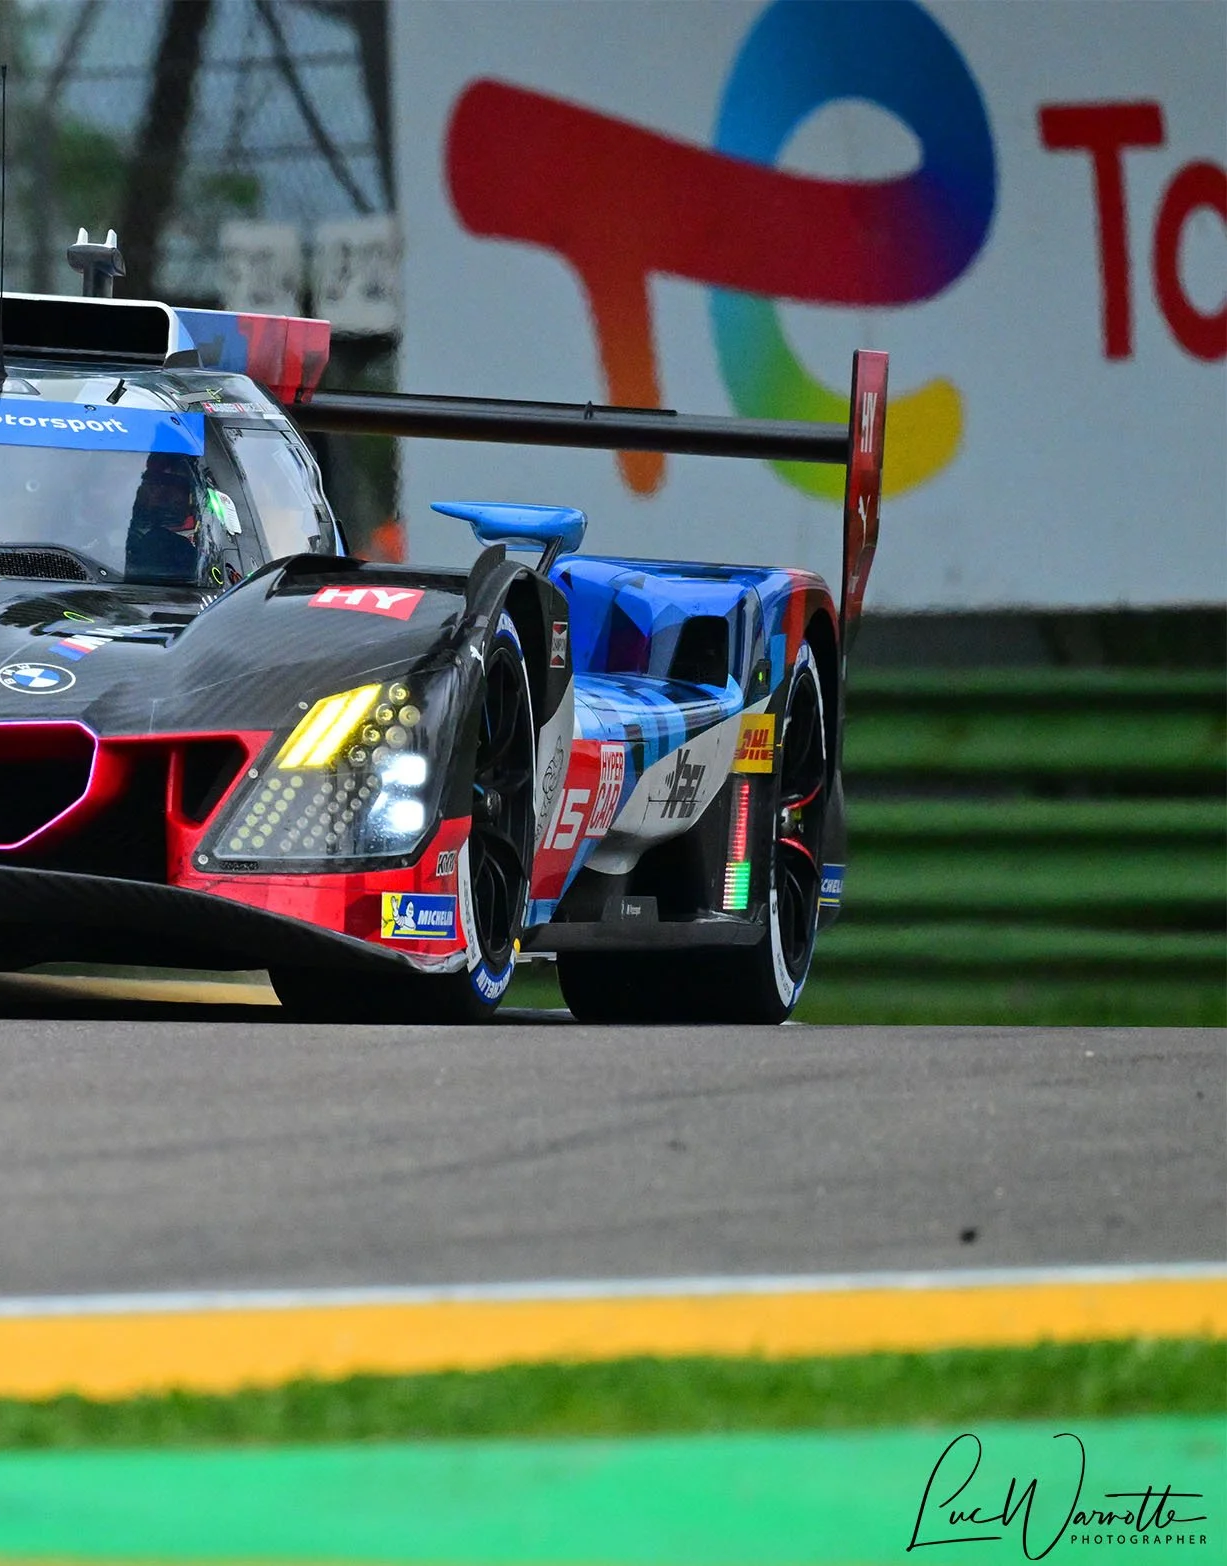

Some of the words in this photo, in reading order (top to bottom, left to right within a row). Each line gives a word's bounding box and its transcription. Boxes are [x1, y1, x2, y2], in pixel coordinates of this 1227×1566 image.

[316, 588, 417, 610] HY
[736, 728, 773, 760] DHL
[601, 751, 623, 782] HYPER
[543, 789, 591, 850] 15
[590, 782, 623, 829] CAR
[417, 910, 454, 926] MICHELIN
